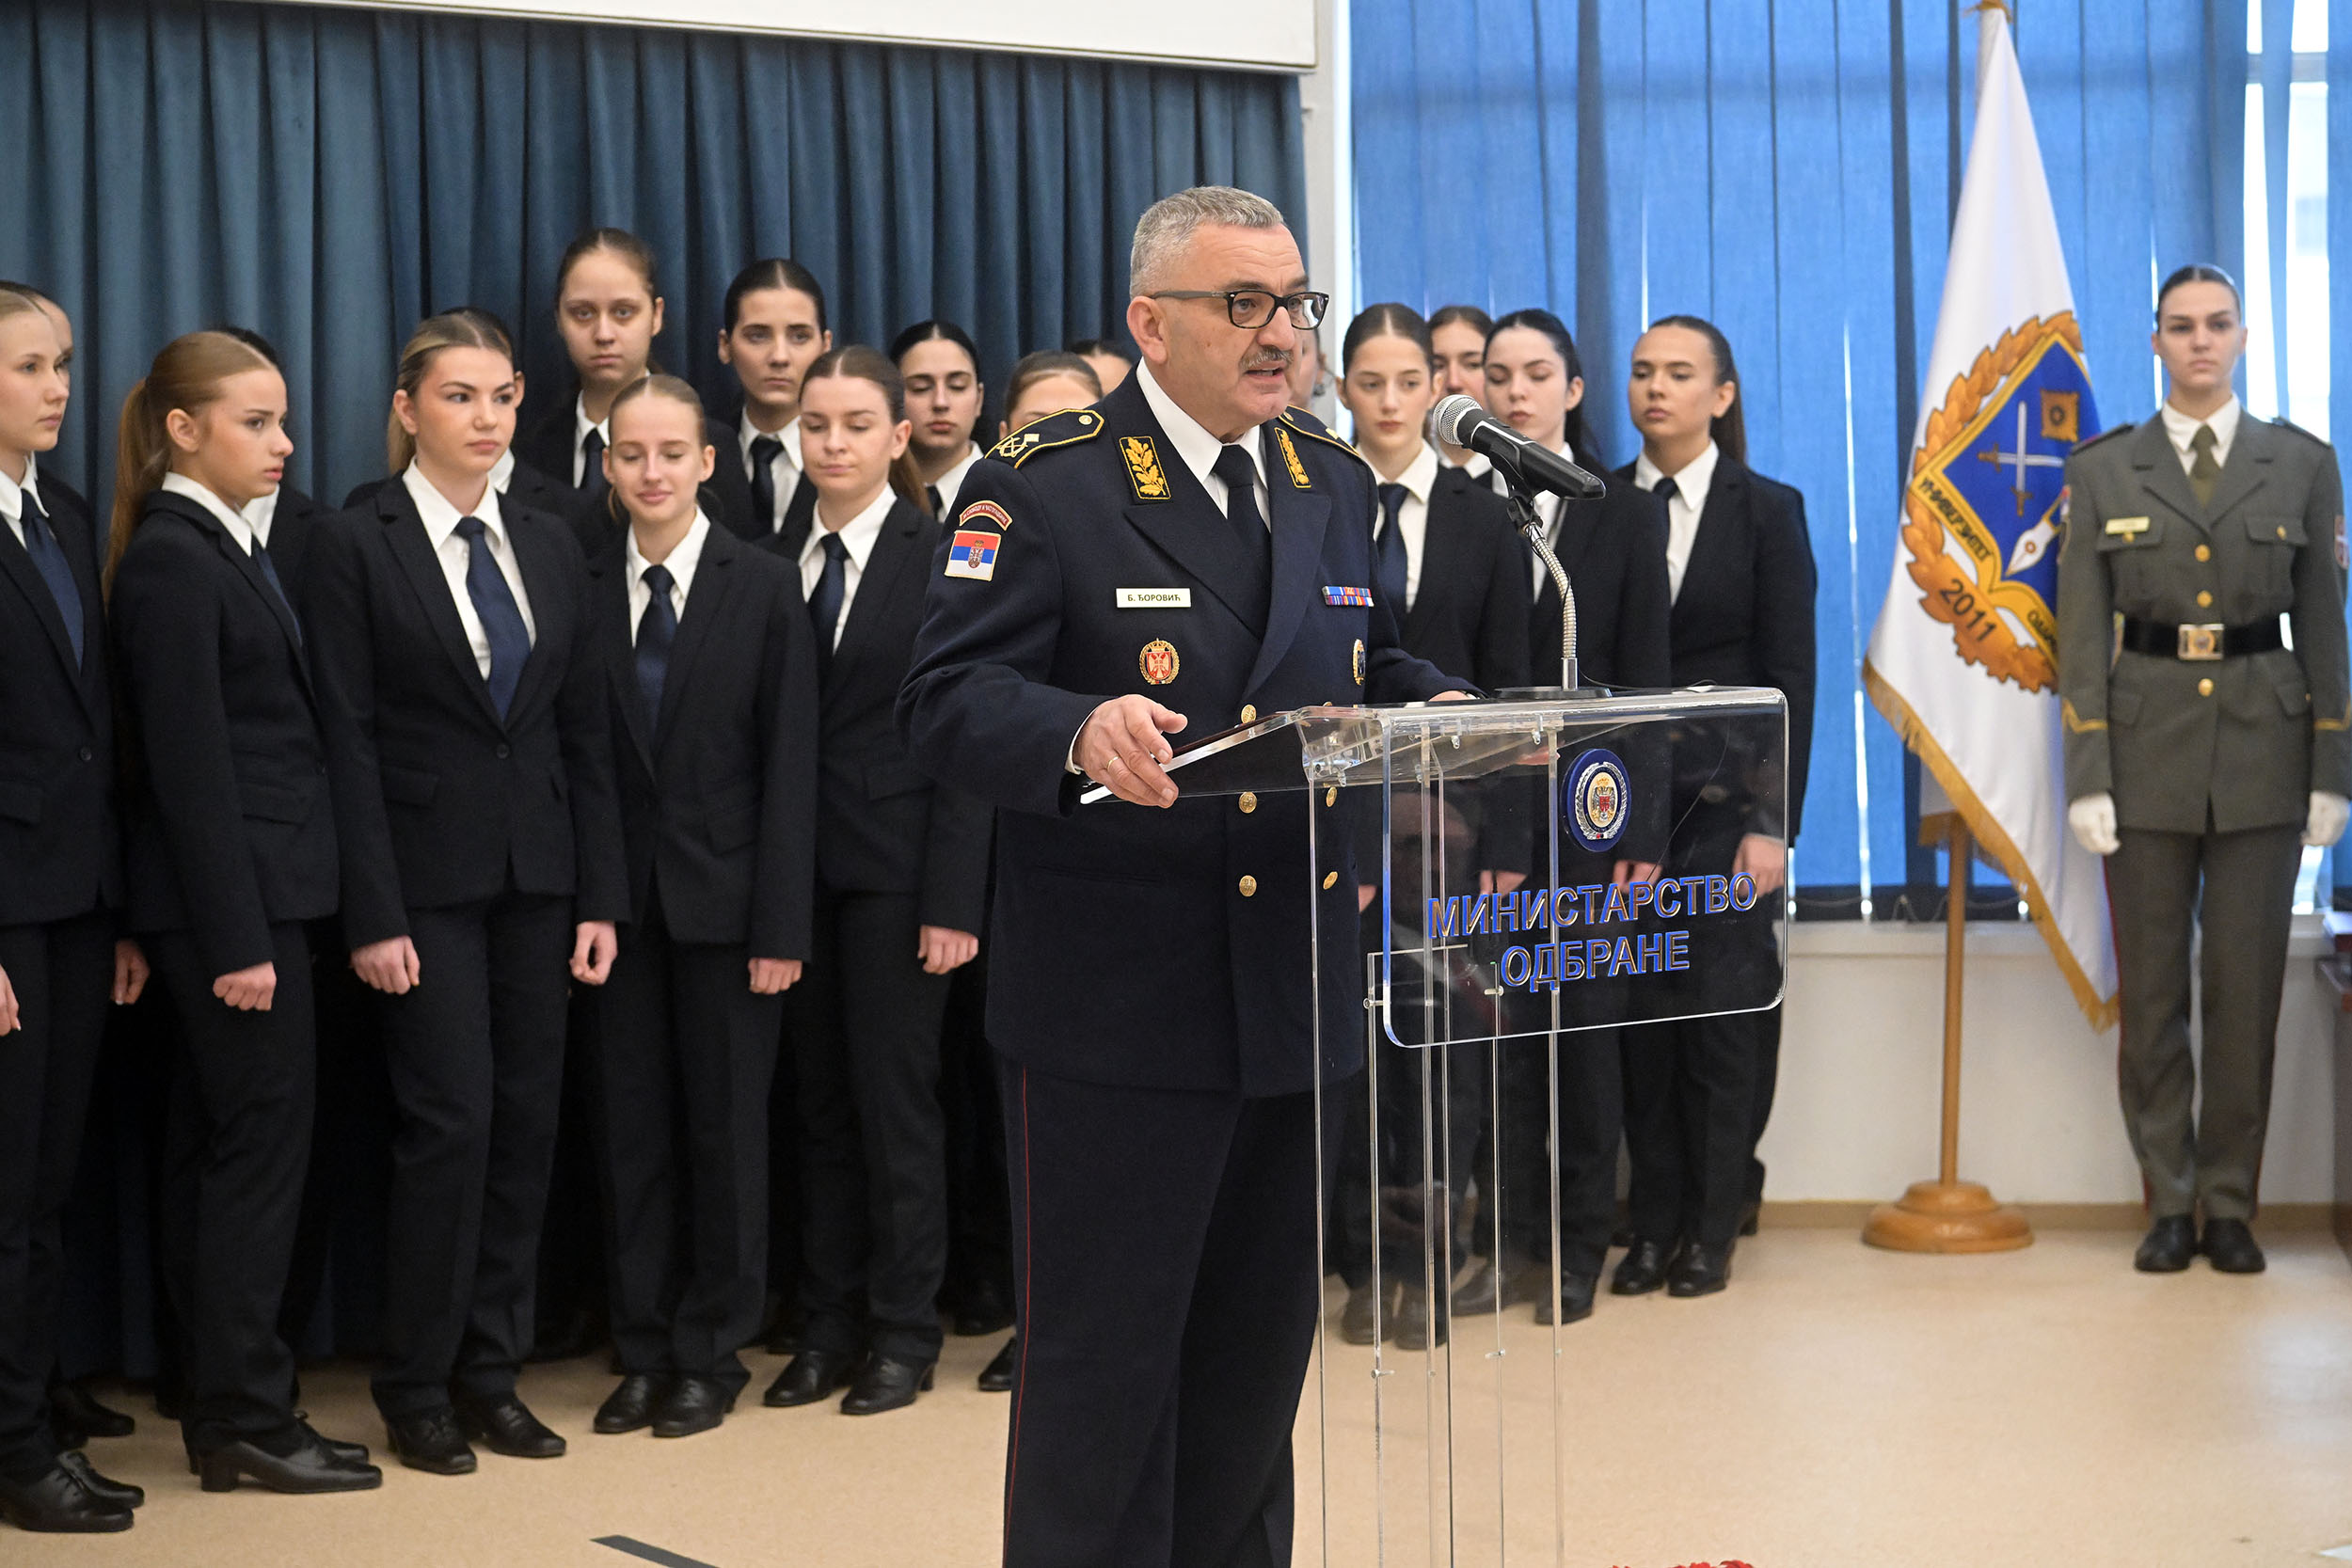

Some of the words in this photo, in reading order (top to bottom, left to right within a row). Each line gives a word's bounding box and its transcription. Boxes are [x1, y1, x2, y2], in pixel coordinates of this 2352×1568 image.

[1127, 594, 1136, 602] Б.
[1137, 594, 1181, 602] ЂОРОВИЋ
[1939, 577, 1996, 642] 2011
[1427, 872, 1758, 939] МИНИСТАРСТВО
[1501, 930, 1690, 993] ОДБРАНЕ
